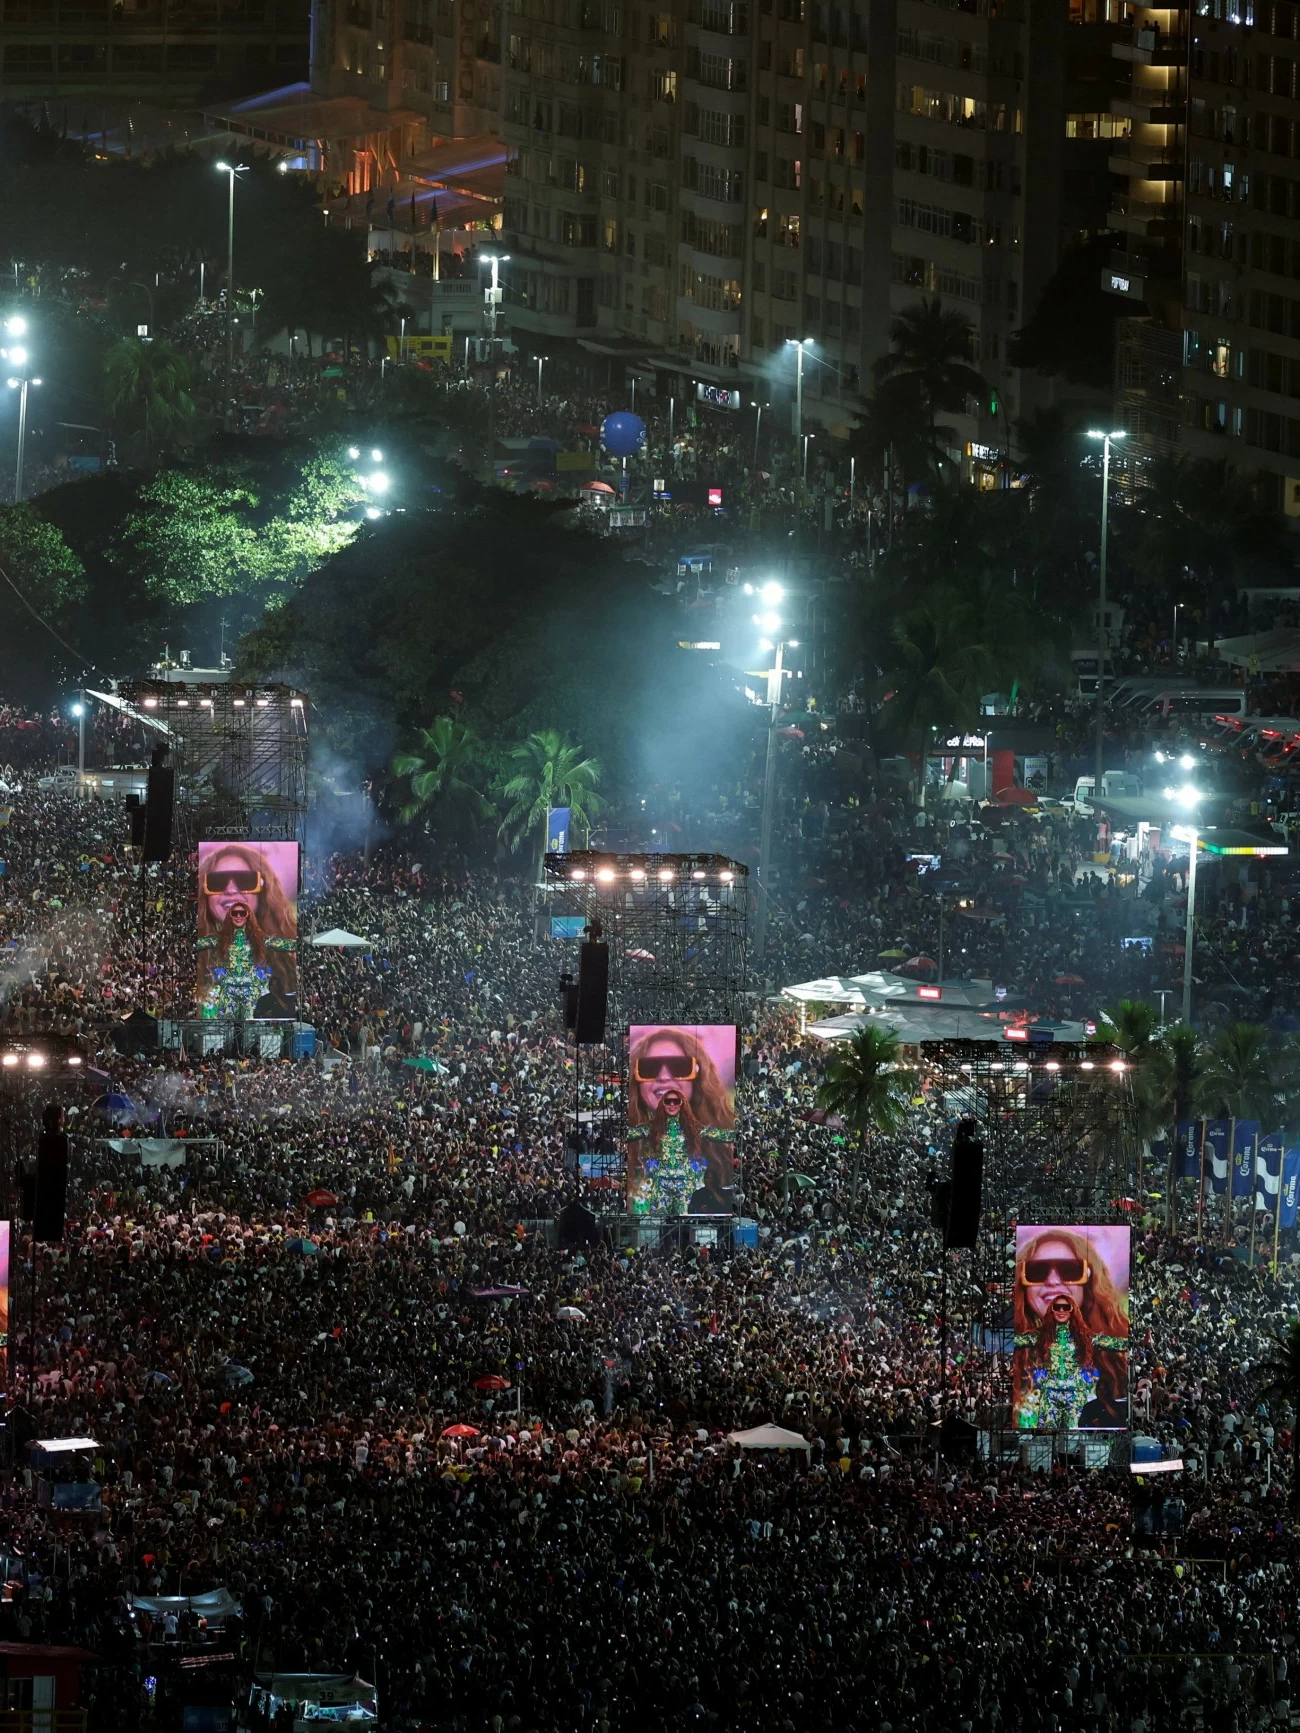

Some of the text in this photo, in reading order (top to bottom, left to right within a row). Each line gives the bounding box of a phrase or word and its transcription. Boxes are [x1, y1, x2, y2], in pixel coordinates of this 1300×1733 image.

[557, 829, 566, 853] orona
[1186, 1126, 1195, 1157] Corona
[1239, 1146, 1252, 1177] Corona
[1286, 1174, 1298, 1208] Corona
[319, 1691, 334, 1700] 39
